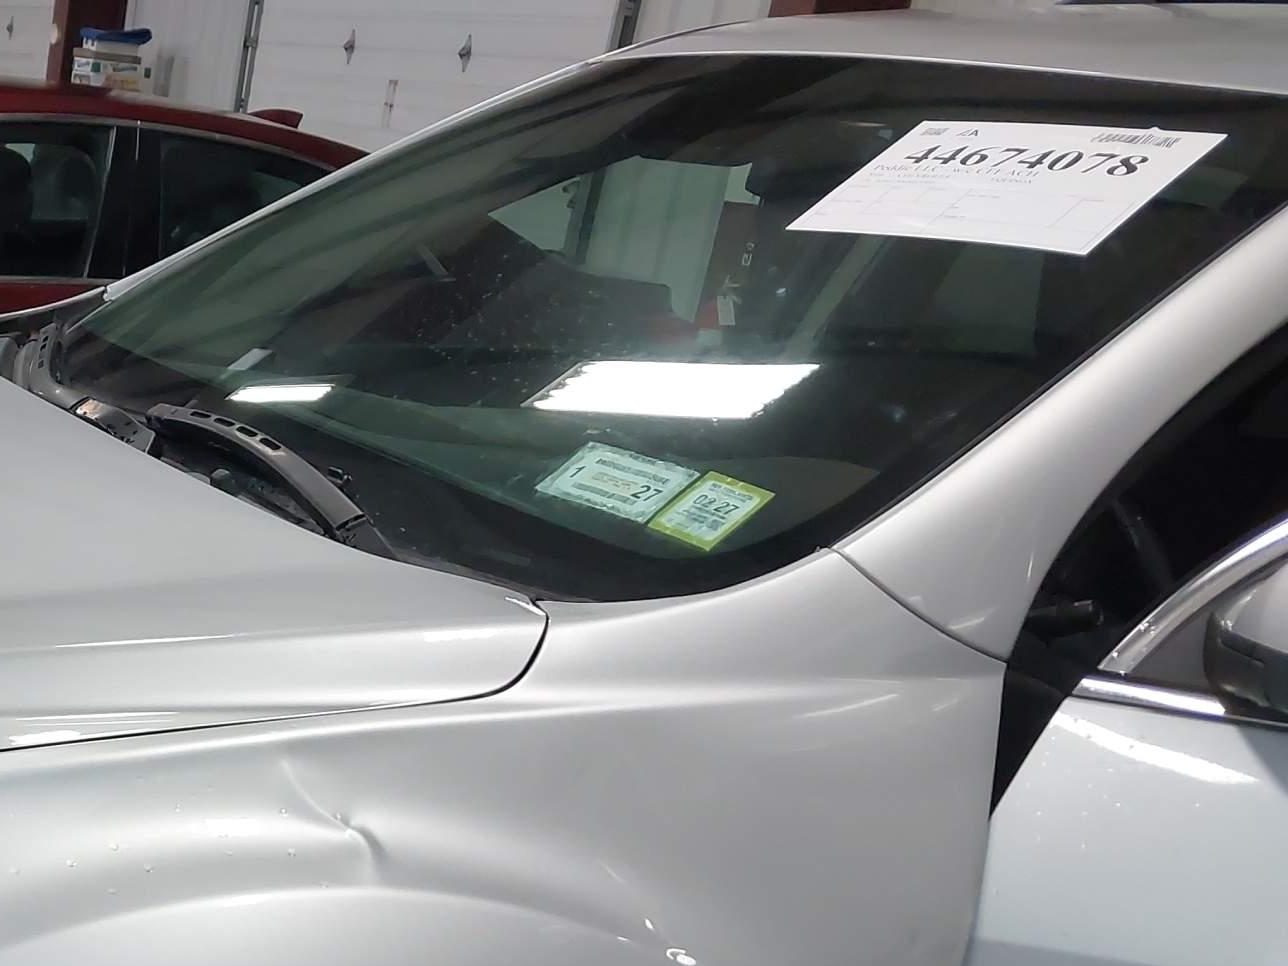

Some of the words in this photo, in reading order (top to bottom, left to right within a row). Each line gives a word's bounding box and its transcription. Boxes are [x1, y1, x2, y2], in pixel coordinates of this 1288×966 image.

[904, 144, 1150, 177] 44674078
[569, 466, 587, 478] 1
[631, 484, 664, 502] 27
